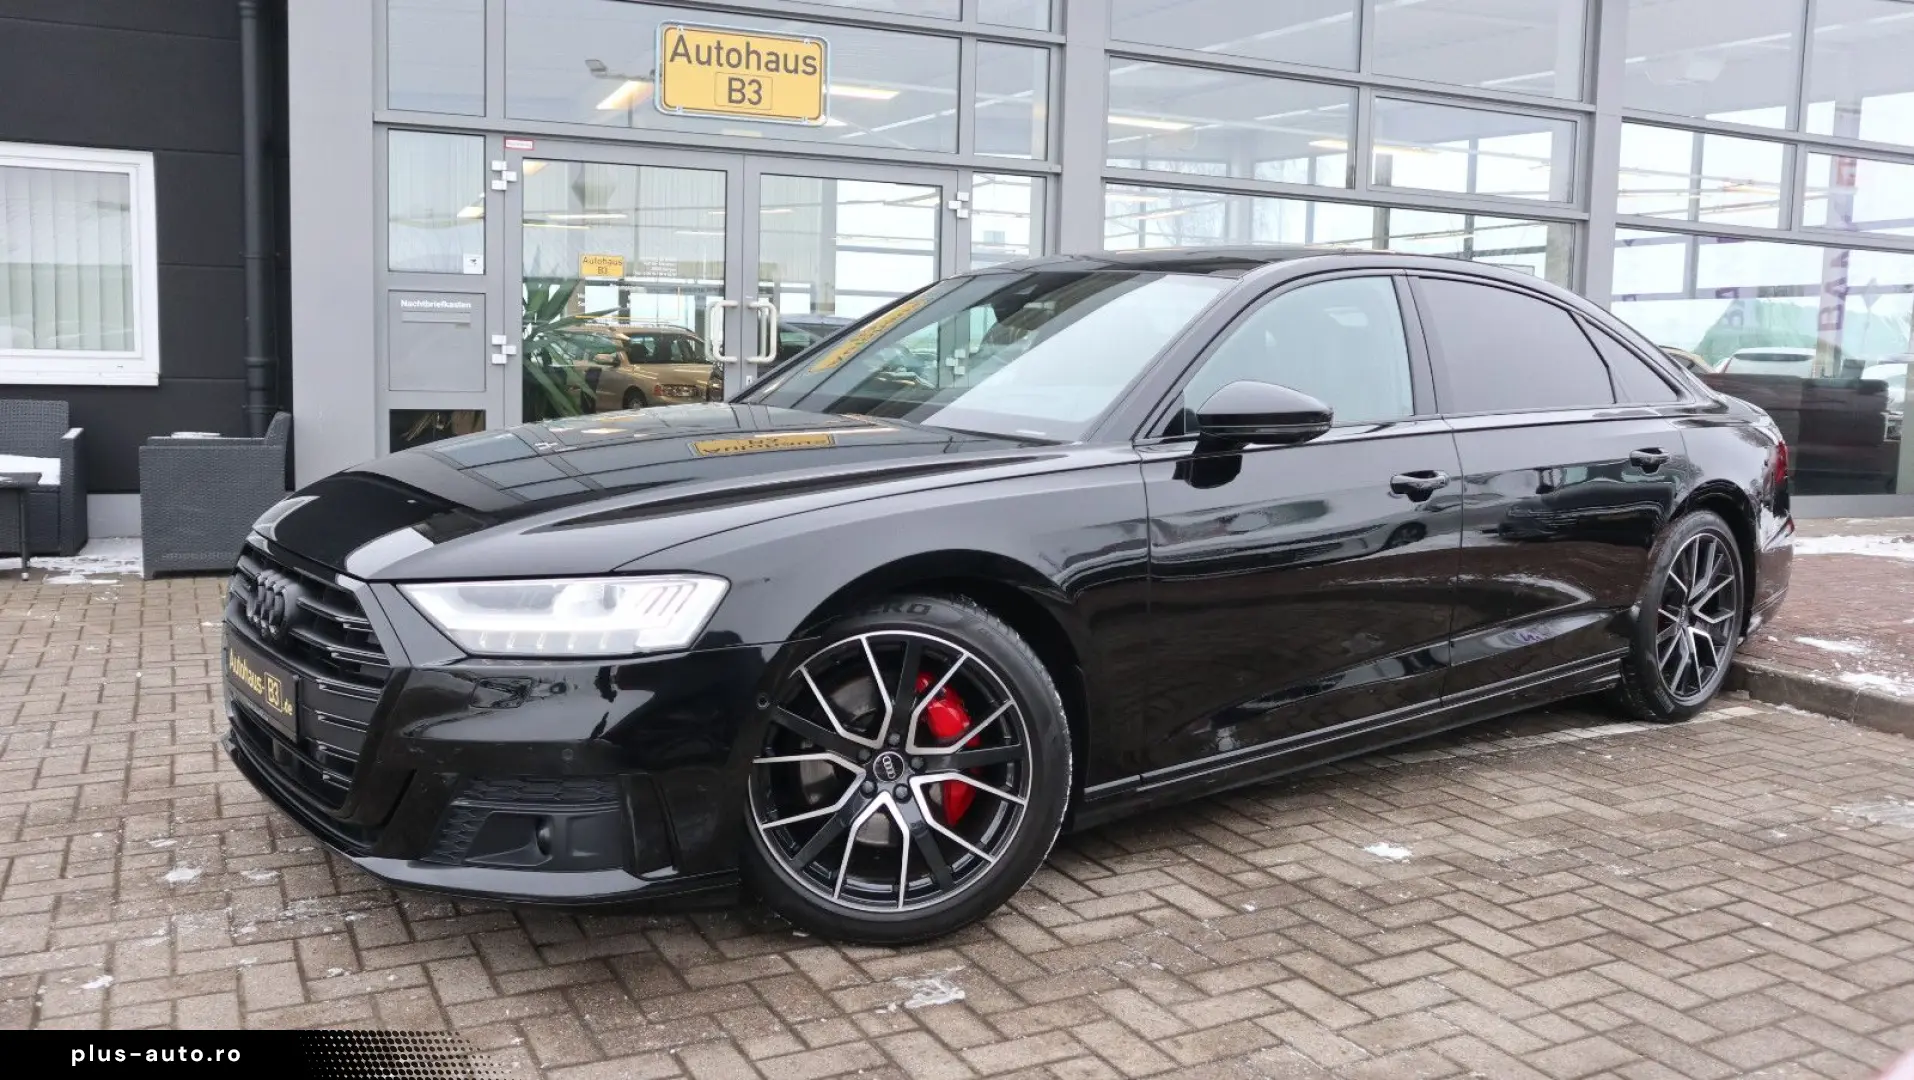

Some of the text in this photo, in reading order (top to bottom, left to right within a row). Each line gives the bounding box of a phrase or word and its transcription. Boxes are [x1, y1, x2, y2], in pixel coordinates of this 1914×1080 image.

[669, 34, 818, 76] Autohaus
[727, 76, 763, 106] B3
[582, 256, 623, 266] Autohaus
